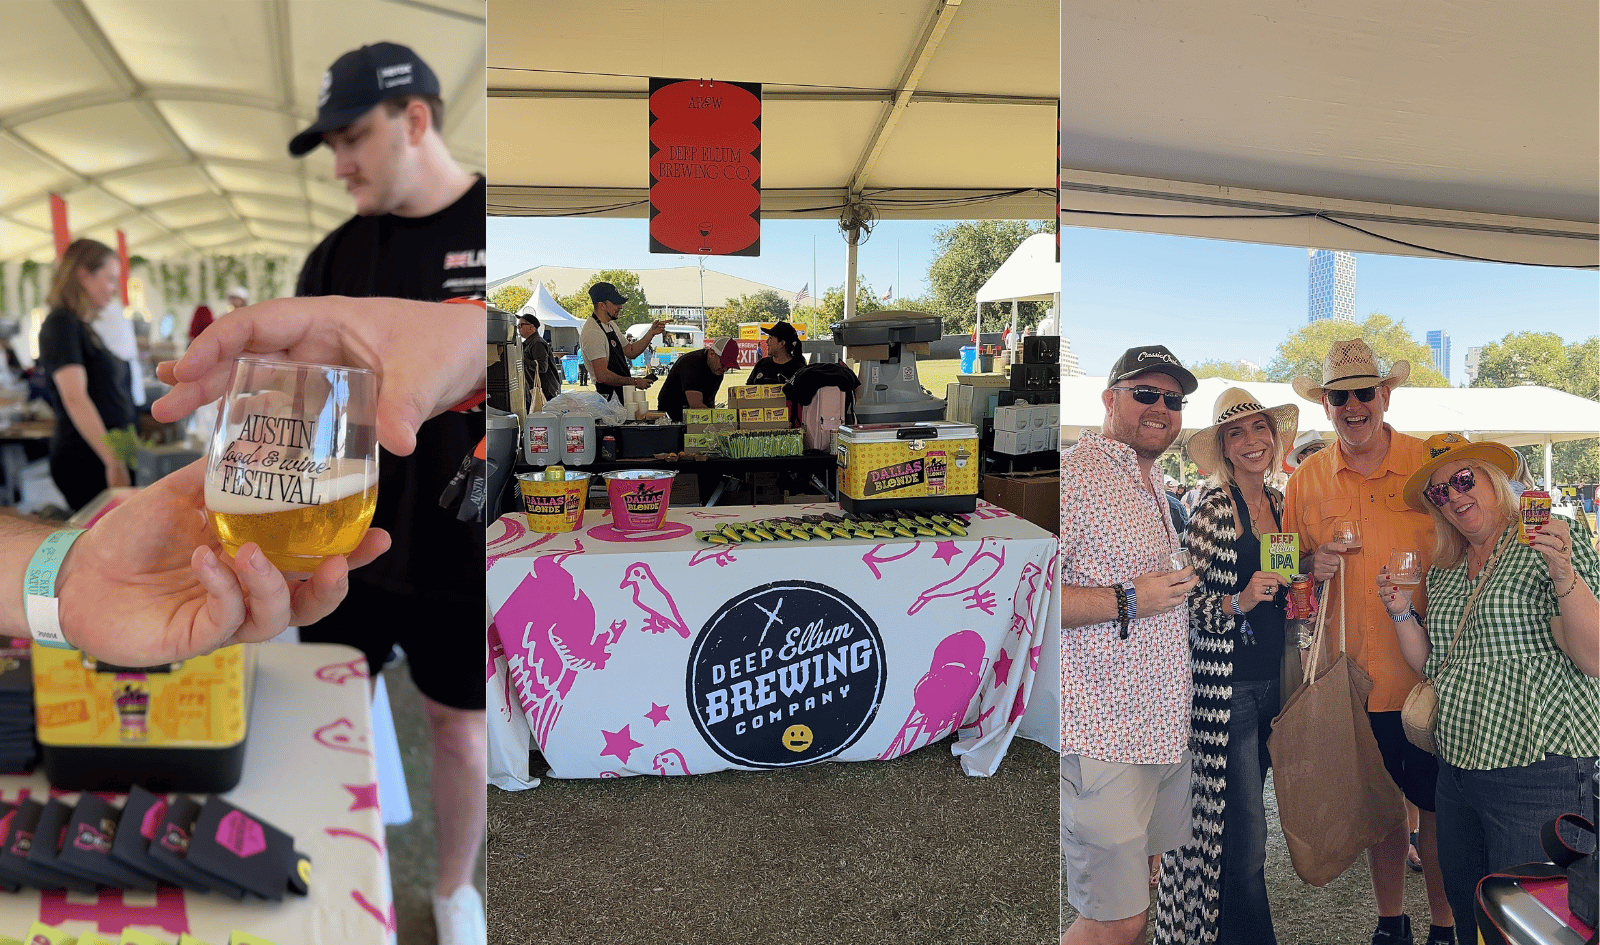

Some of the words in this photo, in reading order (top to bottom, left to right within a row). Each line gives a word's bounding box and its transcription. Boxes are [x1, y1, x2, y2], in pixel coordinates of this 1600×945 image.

[670, 145, 698, 161] DEEP
[702, 146, 742, 163] ELLUM
[659, 162, 719, 179] BREWING
[723, 165, 752, 181] CO.
[237, 414, 316, 449] AUSTIN
[215, 441, 262, 472] food
[262, 451, 280, 467] &
[278, 456, 332, 475] wine
[870, 460, 923, 483] DALLAS
[220, 464, 322, 506] FESTIVAL
[873, 472, 920, 492] BLONDE
[526, 495, 564, 506] DALLAS
[528, 504, 561, 513] BLONDE
[627, 495, 663, 504] DALLAS
[627, 502, 660, 511] BLONDE
[1270, 534, 1294, 544] DEEP
[711, 647, 774, 685] DEEP
[777, 618, 855, 662] Ellum
[705, 638, 873, 726] BREWING
[735, 684, 850, 736] COMPANY
